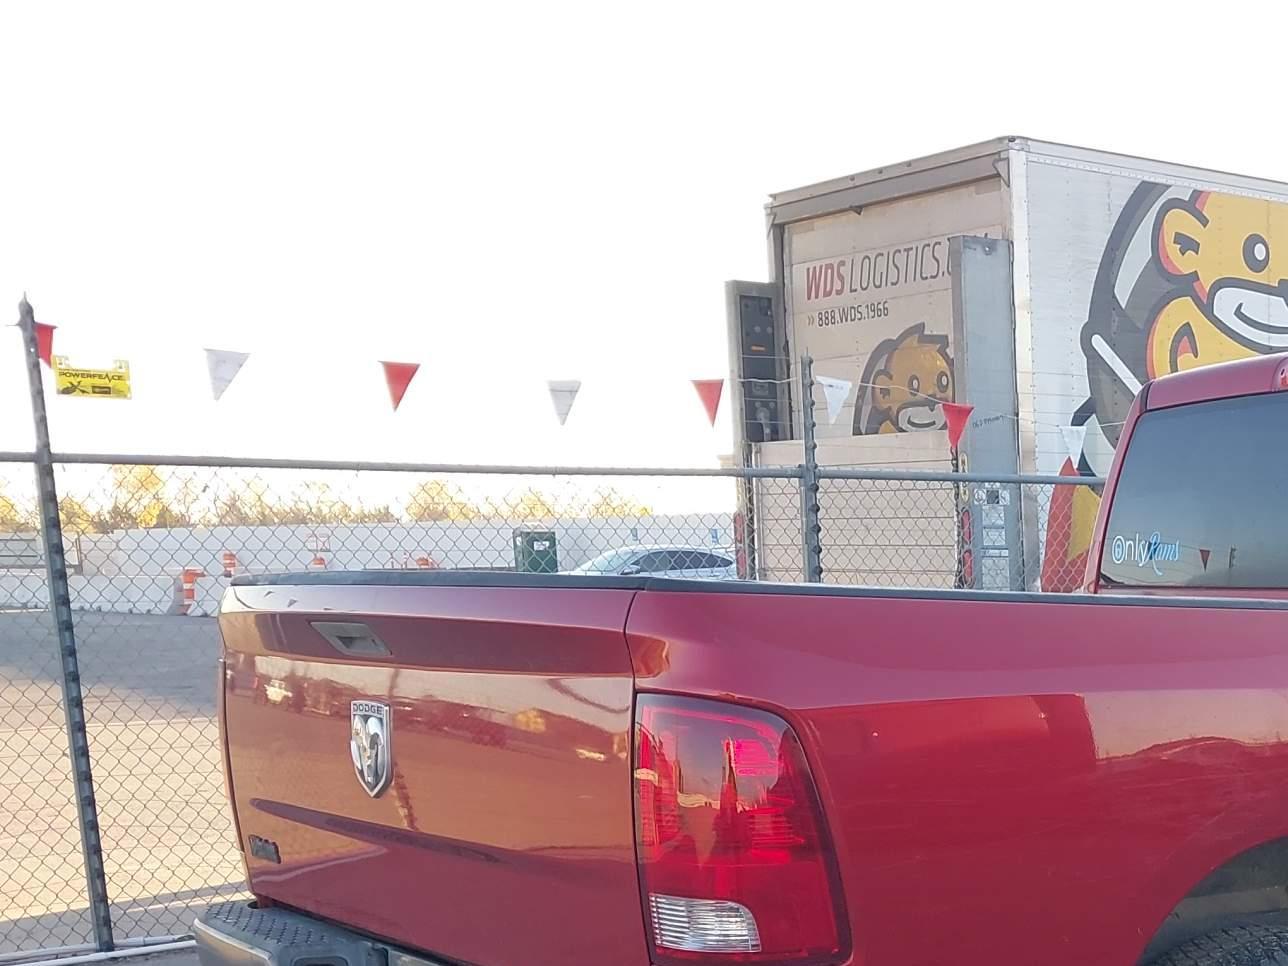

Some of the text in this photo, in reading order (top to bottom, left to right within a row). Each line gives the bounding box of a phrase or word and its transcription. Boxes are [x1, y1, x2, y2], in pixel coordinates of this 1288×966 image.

[806, 259, 847, 300] WDS
[817, 301, 889, 327] 888.WDS.1966
[352, 703, 383, 715] DODGE
